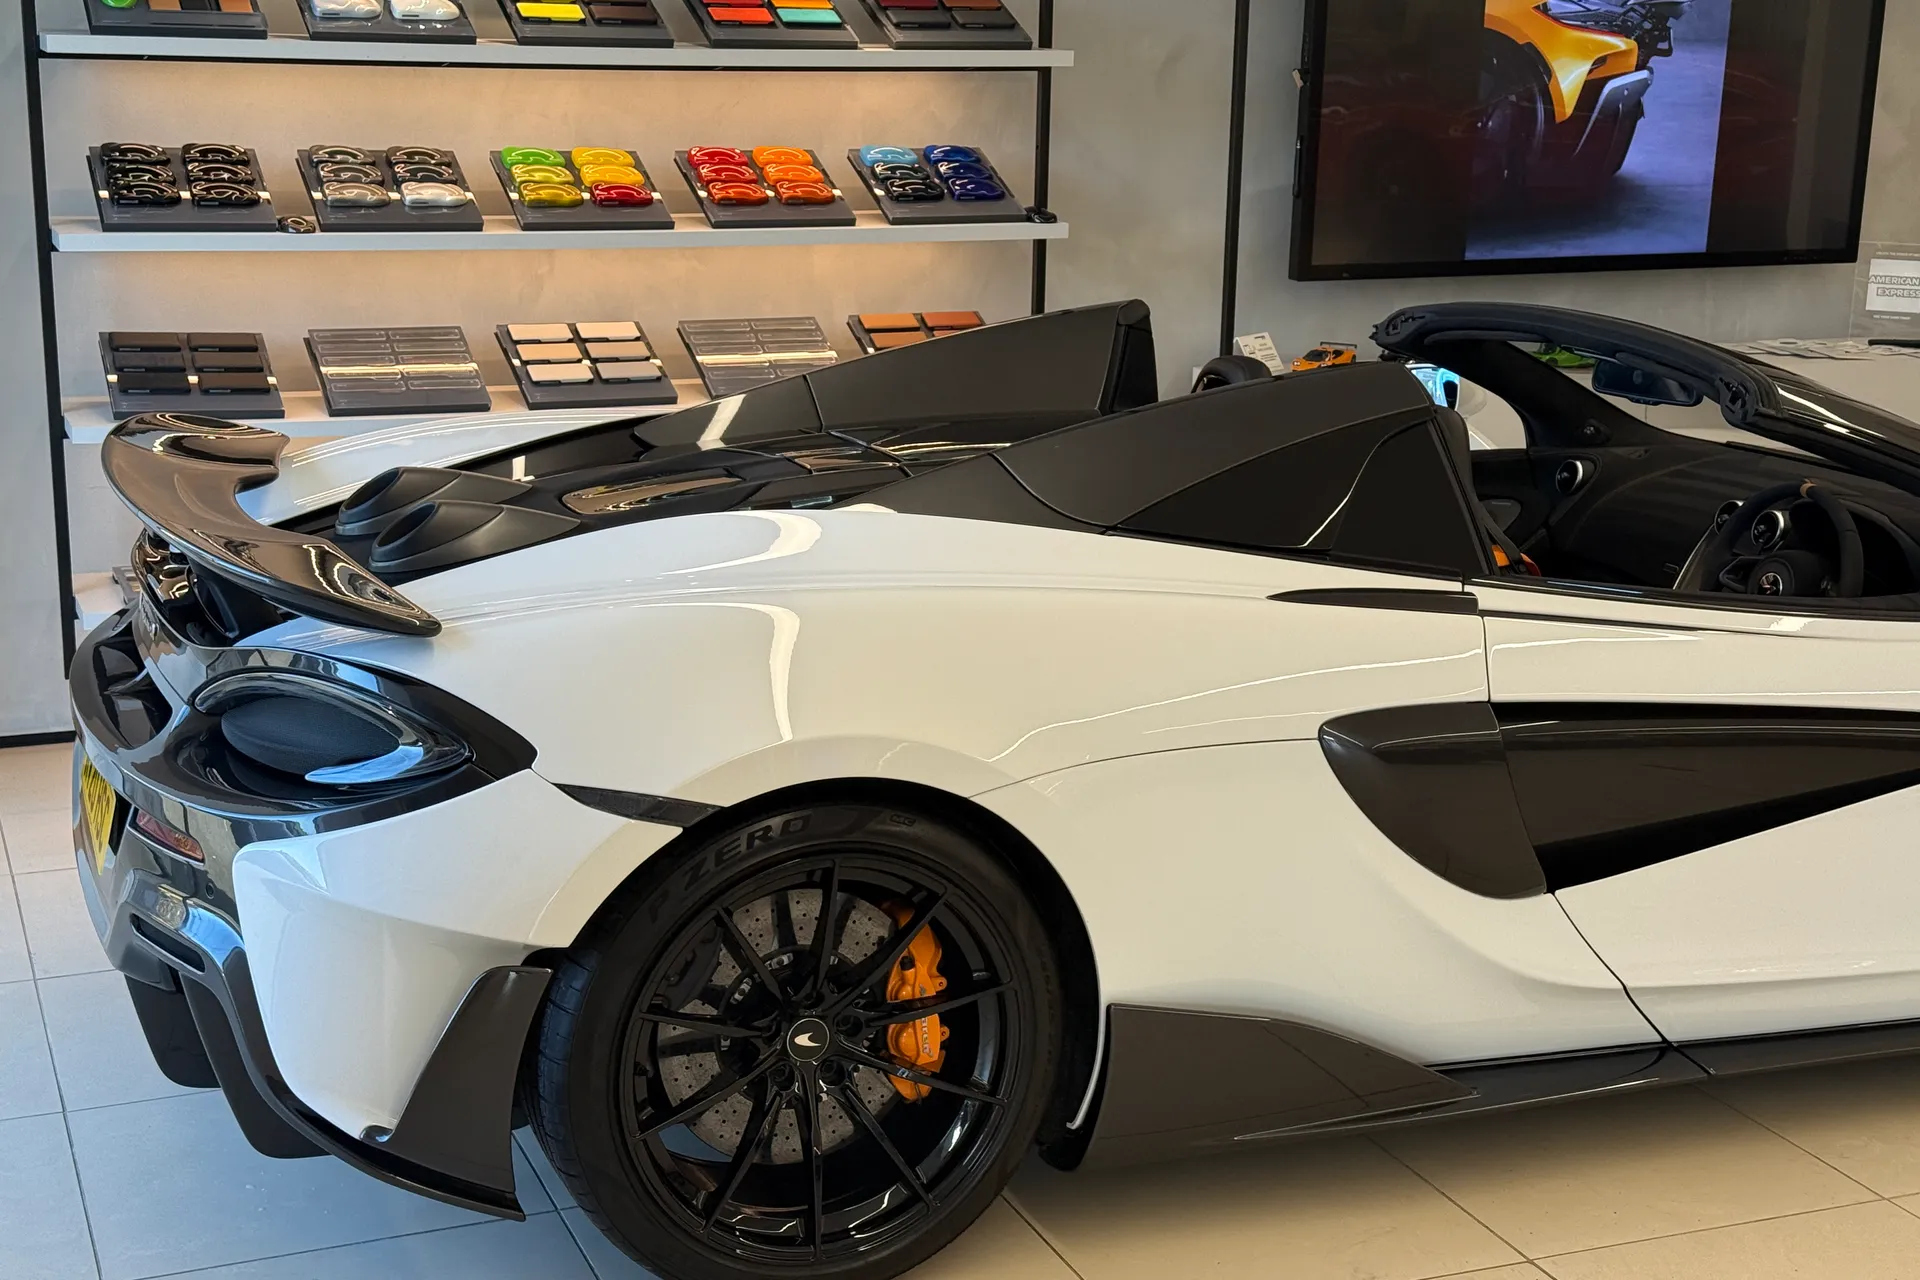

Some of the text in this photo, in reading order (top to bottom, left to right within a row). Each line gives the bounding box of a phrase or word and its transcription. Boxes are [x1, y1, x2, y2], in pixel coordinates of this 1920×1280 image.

[1868, 275, 1920, 286] AMERICAN
[1877, 287, 1920, 298] EXPRESS
[649, 811, 815, 924] P ZERO
